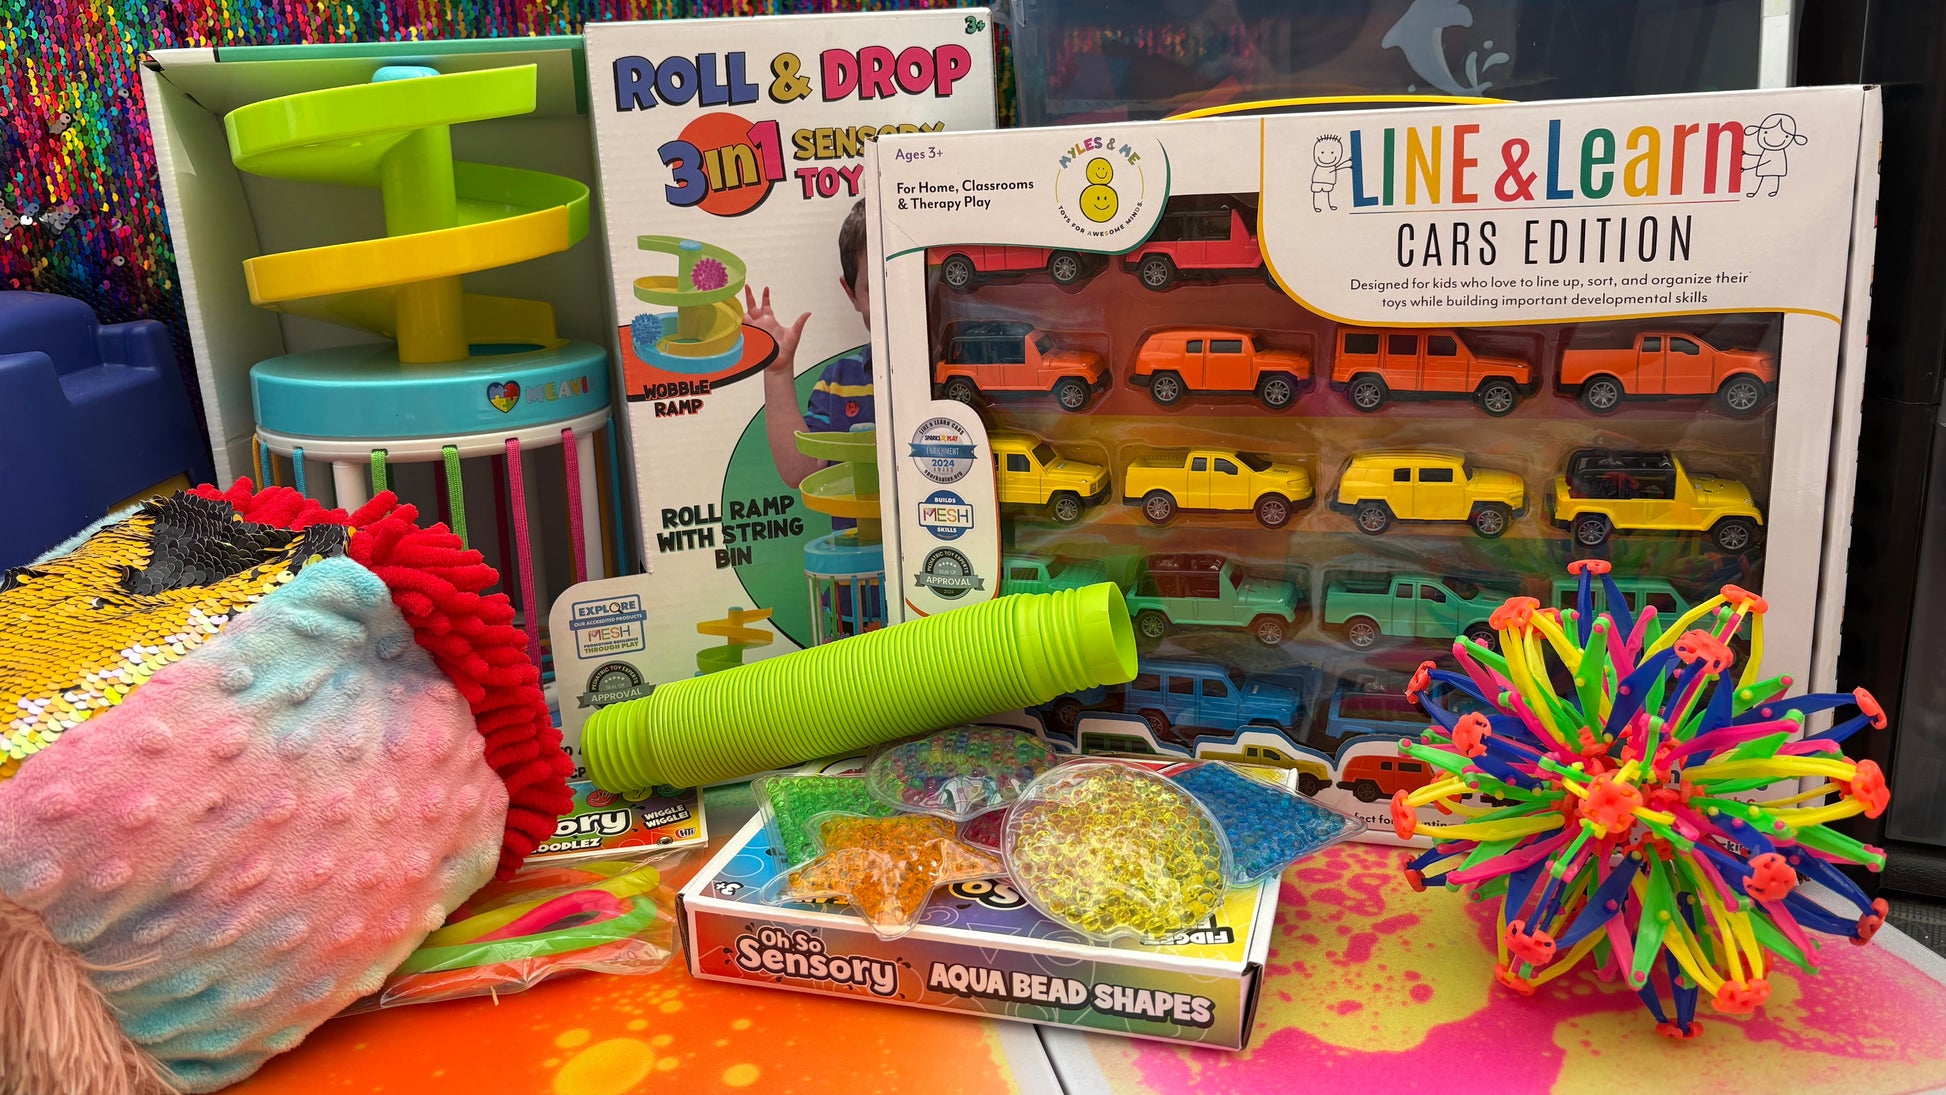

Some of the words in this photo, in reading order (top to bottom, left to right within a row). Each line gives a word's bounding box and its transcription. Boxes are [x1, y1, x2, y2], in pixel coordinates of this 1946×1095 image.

[964, 16, 986, 35] 3+
[613, 51, 760, 112] ROLL
[768, 52, 814, 104] &
[820, 44, 972, 101] DROP
[895, 148, 926, 163] Ages
[928, 146, 944, 159] 3+
[1059, 137, 1103, 169] MYLES
[1106, 138, 1116, 151] &
[1119, 144, 1141, 166] ME
[1349, 123, 1480, 208] LINE
[1494, 138, 1538, 201] &
[1546, 118, 1744, 200] Learn
[794, 164, 864, 199] TOY
[897, 182, 916, 195] For
[918, 181, 959, 196] Home,
[962, 179, 1035, 193] Classrooms
[898, 199, 908, 210] &
[911, 198, 961, 213] Therapy
[964, 195, 991, 210] Play
[1058, 205, 1072, 224] TOYS
[1071, 222, 1086, 234] FOR
[1087, 224, 1125, 237] AWESOME
[1125, 201, 1144, 226] MINDS
[1397, 220, 1498, 268] CARS
[1524, 215, 1693, 265] EDITION
[1350, 278, 1409, 293] Designed
[1412, 277, 1430, 289] for
[1433, 276, 1457, 289] kids
[1460, 276, 1488, 288] who
[1491, 275, 1517, 288] love
[1520, 277, 1533, 288] to
[1536, 275, 1560, 287] line
[1563, 279, 1584, 290] up,
[1587, 275, 1617, 288] sort,
[1621, 273, 1648, 286] and
[1651, 273, 1712, 288] organize
[1716, 271, 1749, 284] their
[1382, 297, 1407, 310] toys
[1410, 295, 1443, 308] while
[1446, 294, 1499, 309] building
[1502, 294, 1567, 309] important
[1571, 291, 1672, 308] developmental
[1675, 290, 1708, 304] skills
[642, 379, 712, 400] WOBBLE
[654, 398, 705, 418] RAMP
[931, 458, 955, 468] 2024
[934, 496, 956, 504] BUILDS
[661, 503, 722, 529] ROLL
[729, 495, 795, 521] RAMP
[922, 507, 969, 524] MESH
[656, 527, 715, 554] WITH
[722, 517, 804, 544] STRING
[714, 546, 752, 570] BIN
[926, 576, 971, 586] APPROVAL
[578, 601, 636, 617] EXPLORE
[588, 624, 631, 642] MESH
[584, 644, 621, 654] THROUGH
[621, 641, 639, 649] PLAY
[591, 687, 642, 702] APPROVAL
[644, 804, 686, 821] WIGGLE
[645, 811, 690, 828] WIGGLE!
[533, 837, 602, 853] OODLEZ
[760, 928, 790, 949] Oh
[795, 932, 822, 953] So
[737, 937, 895, 994] Sensory
[929, 962, 1007, 997] AQUA
[1012, 971, 1088, 1005] BEAD
[1093, 982, 1213, 1024] SHAPES
